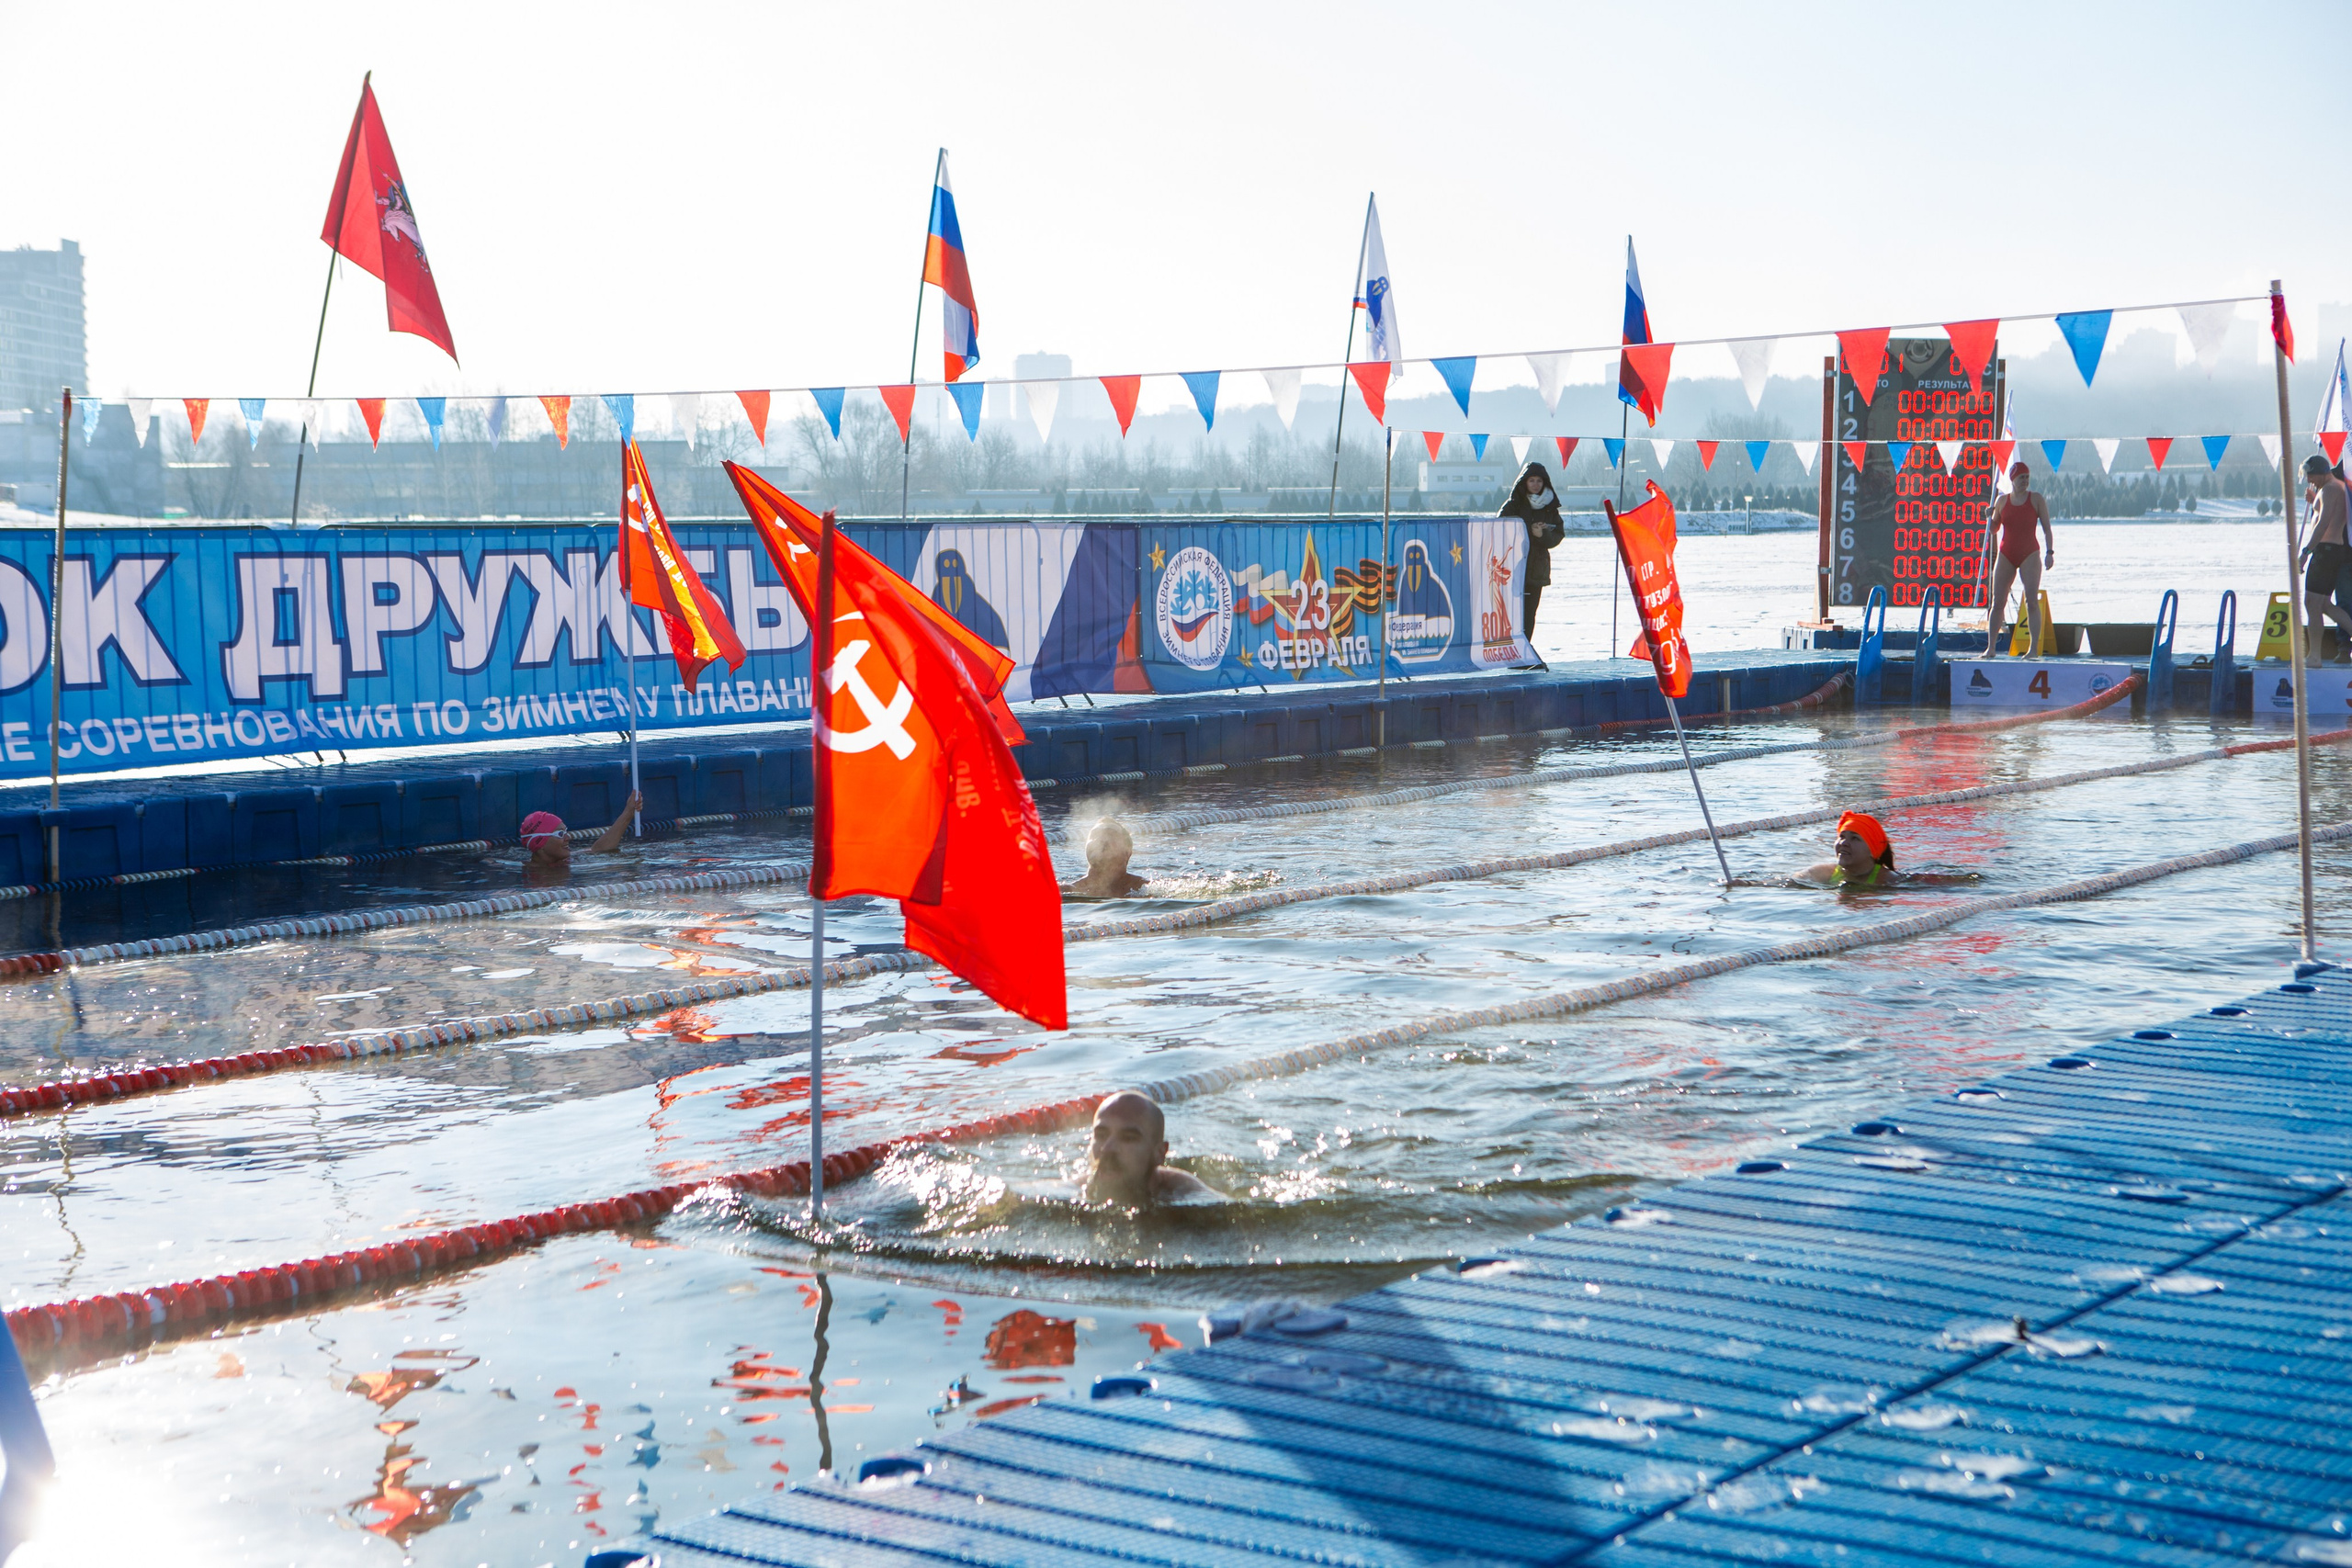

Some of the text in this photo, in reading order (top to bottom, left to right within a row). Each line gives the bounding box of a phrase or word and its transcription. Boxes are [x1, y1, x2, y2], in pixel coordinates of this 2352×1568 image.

[1917, 379, 1970, 389] РЕЗУЛЬТА
[1843, 390, 1994, 414] 1 00:00:00
[1842, 418, 1993, 441] 2 00:00:00
[1841, 473, 1857, 494] 4
[1840, 501, 1856, 523] 5
[1839, 527, 1855, 549] 6
[1839, 556, 1988, 579] 7 00:00:00
[1159, 551, 1231, 621] ВСЕРОССИЙСКАЯ ФЕДЕРАЦИЯ
[1838, 582, 1853, 604] 8
[1291, 580, 1331, 630] 23
[1391, 620, 1423, 634] Федерация
[1482, 612, 1498, 642] 80
[2266, 610, 2289, 637] 3
[1162, 629, 1201, 666] ЗИМНЕГО
[1258, 636, 1373, 670] ФЕВРАЛЯ
[1482, 646, 1521, 663] ПОБЕДА!
[2028, 670, 2052, 699] 4
[48, 705, 403, 759] СОРЕВНОВАНИЯ
[413, 699, 469, 738] ПО
[481, 685, 659, 732] ЗИМНЕМУ
[672, 677, 812, 717] ПЛАВАНИ
